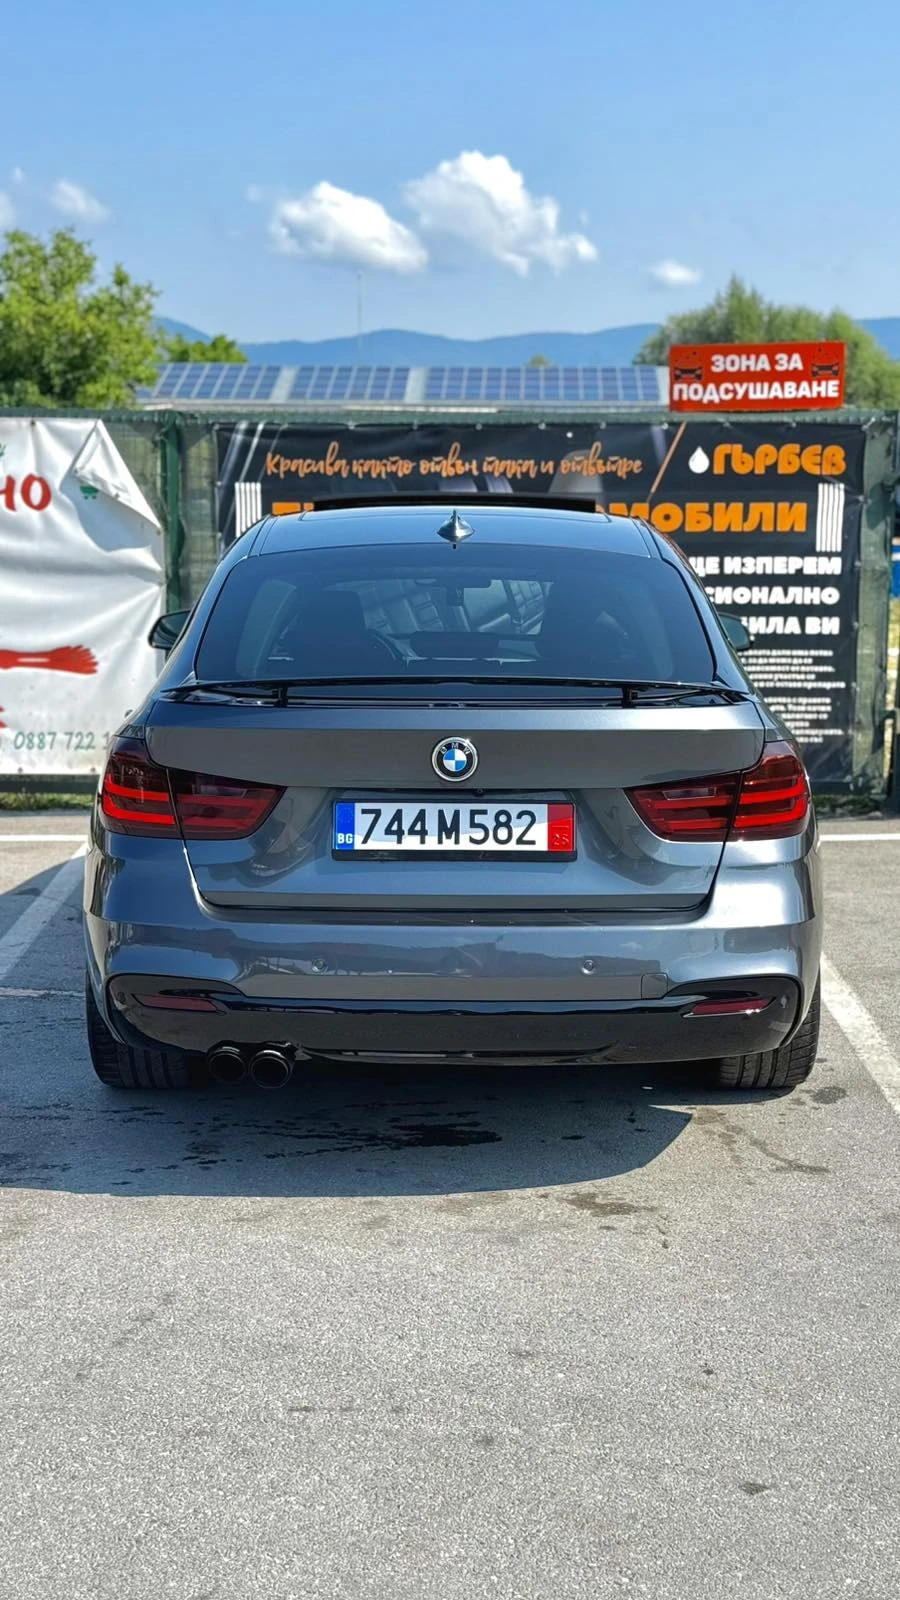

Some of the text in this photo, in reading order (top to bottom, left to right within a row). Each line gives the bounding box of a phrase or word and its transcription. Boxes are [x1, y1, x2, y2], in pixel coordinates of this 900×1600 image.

[711, 352, 803, 373] ЗОНА ЗА
[672, 379, 839, 404] ПОДСУШАВАНЕ
[265, 441, 349, 479] Красива
[352, 455, 416, 479] както
[482, 456, 538, 479] така
[540, 459, 554, 474] и
[723, 556, 842, 575] ИЗПЕРЕМ
[741, 616, 840, 635] ИЛА ВИ
[13, 731, 57, 750] 0887
[64, 731, 96, 750] 722
[337, 832, 353, 844] BG
